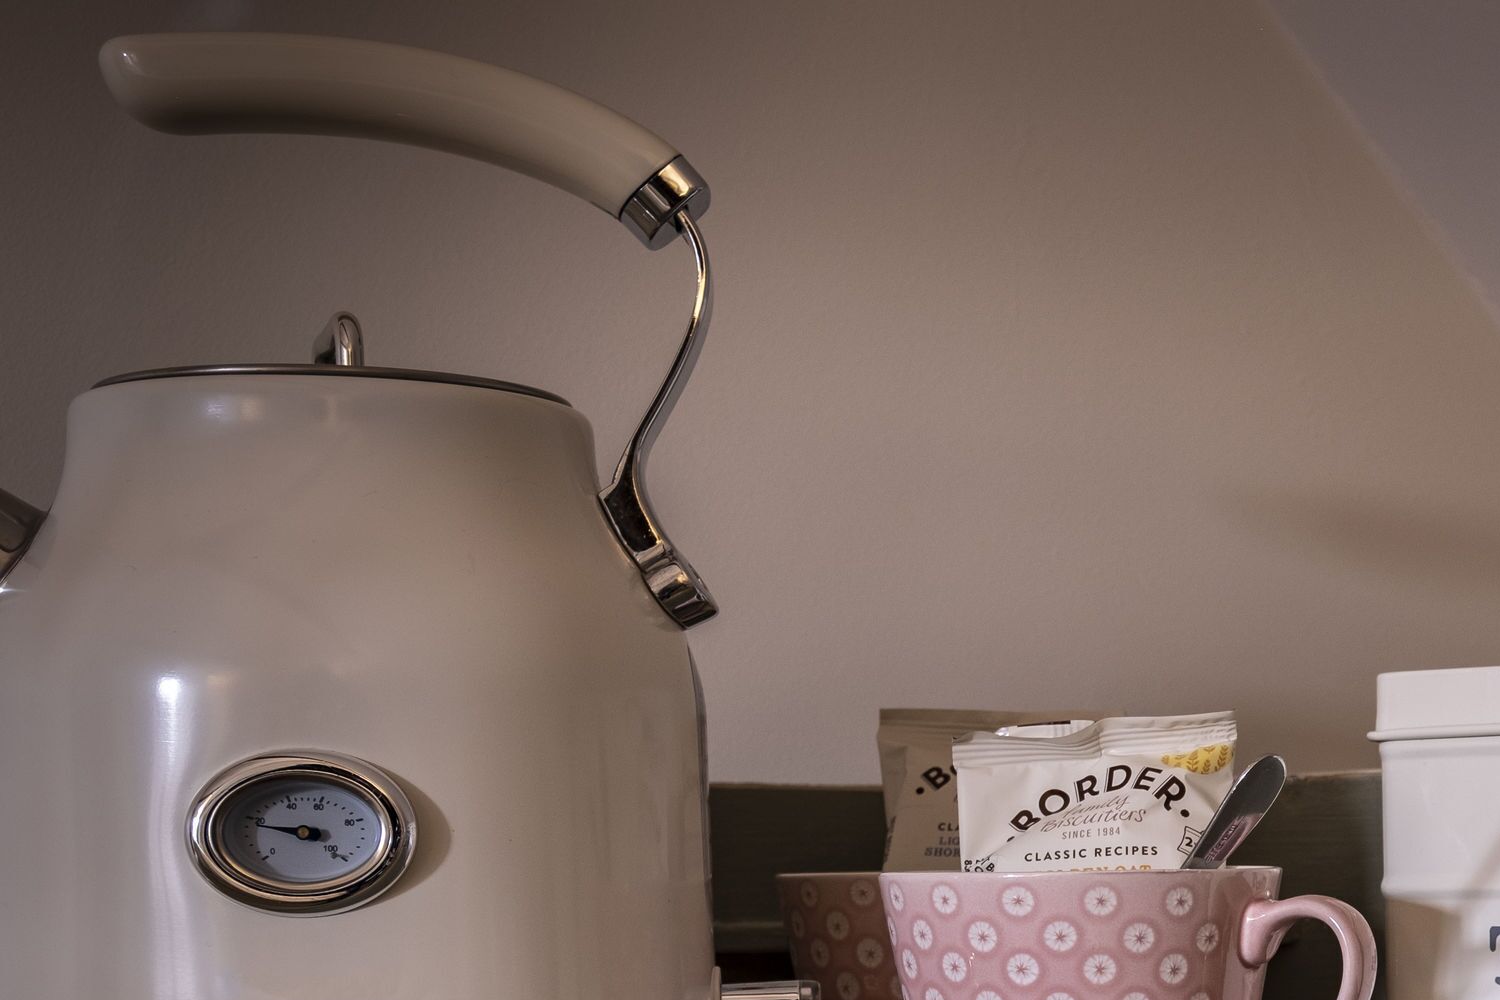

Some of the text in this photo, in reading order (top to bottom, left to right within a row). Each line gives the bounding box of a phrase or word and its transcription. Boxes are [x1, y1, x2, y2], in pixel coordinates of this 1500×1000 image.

[255, 817, 266, 825] 20
[344, 818, 355, 827] 80
[1061, 826, 1121, 840] SINCE 1984
[323, 845, 338, 853] 100
[1024, 846, 1159, 862] CLASSIC RECIPES
